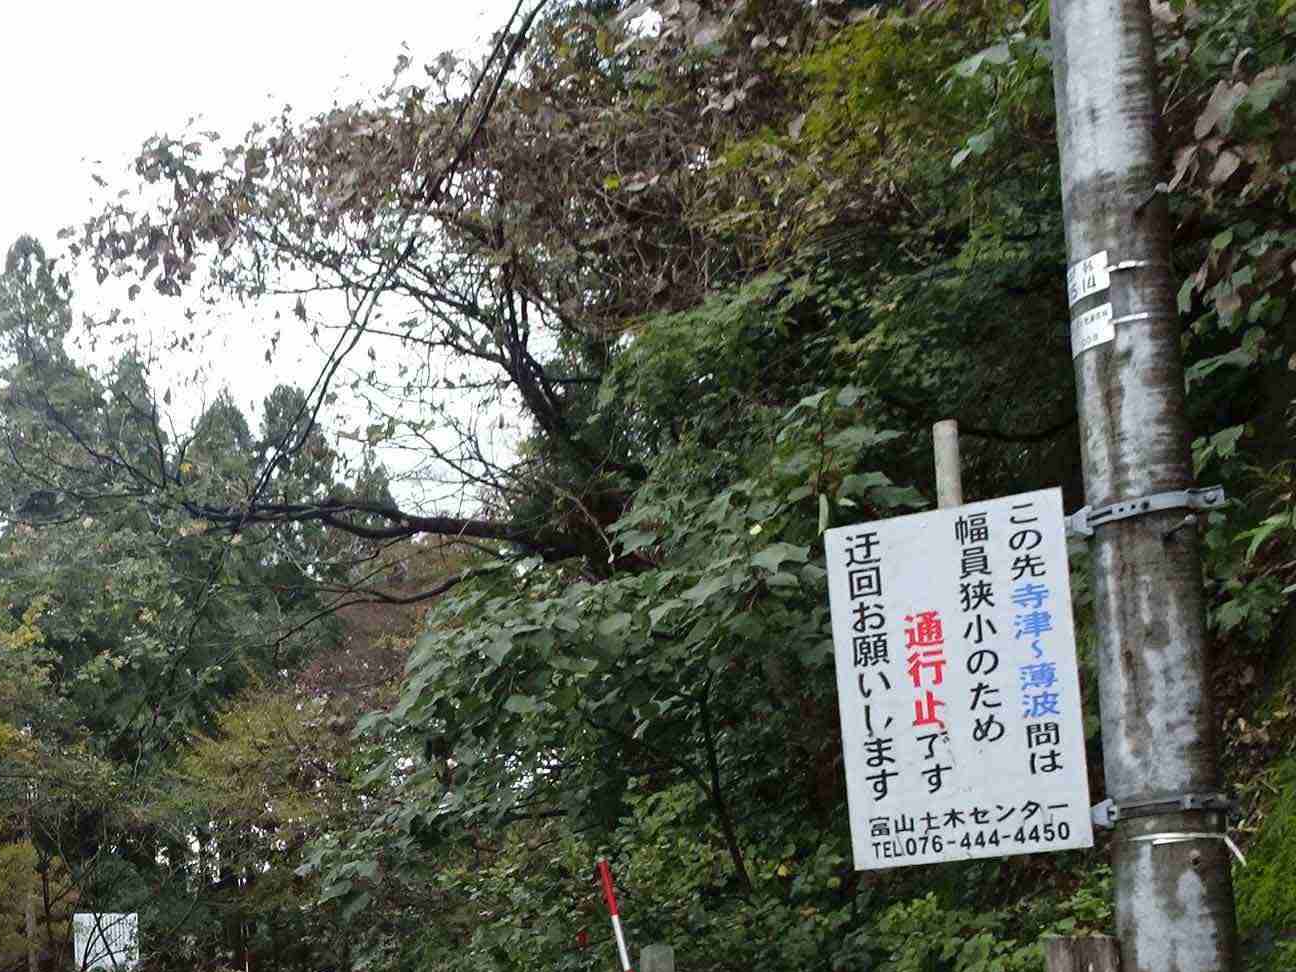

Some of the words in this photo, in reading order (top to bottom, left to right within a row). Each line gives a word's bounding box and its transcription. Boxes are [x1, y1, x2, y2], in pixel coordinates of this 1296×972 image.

[845, 531, 899, 802] 迂回お願いします
[904, 611, 952, 794] 通行止です
[955, 512, 1006, 745] 幅員狭小のため
[869, 800, 1069, 837] 富山土木センター
